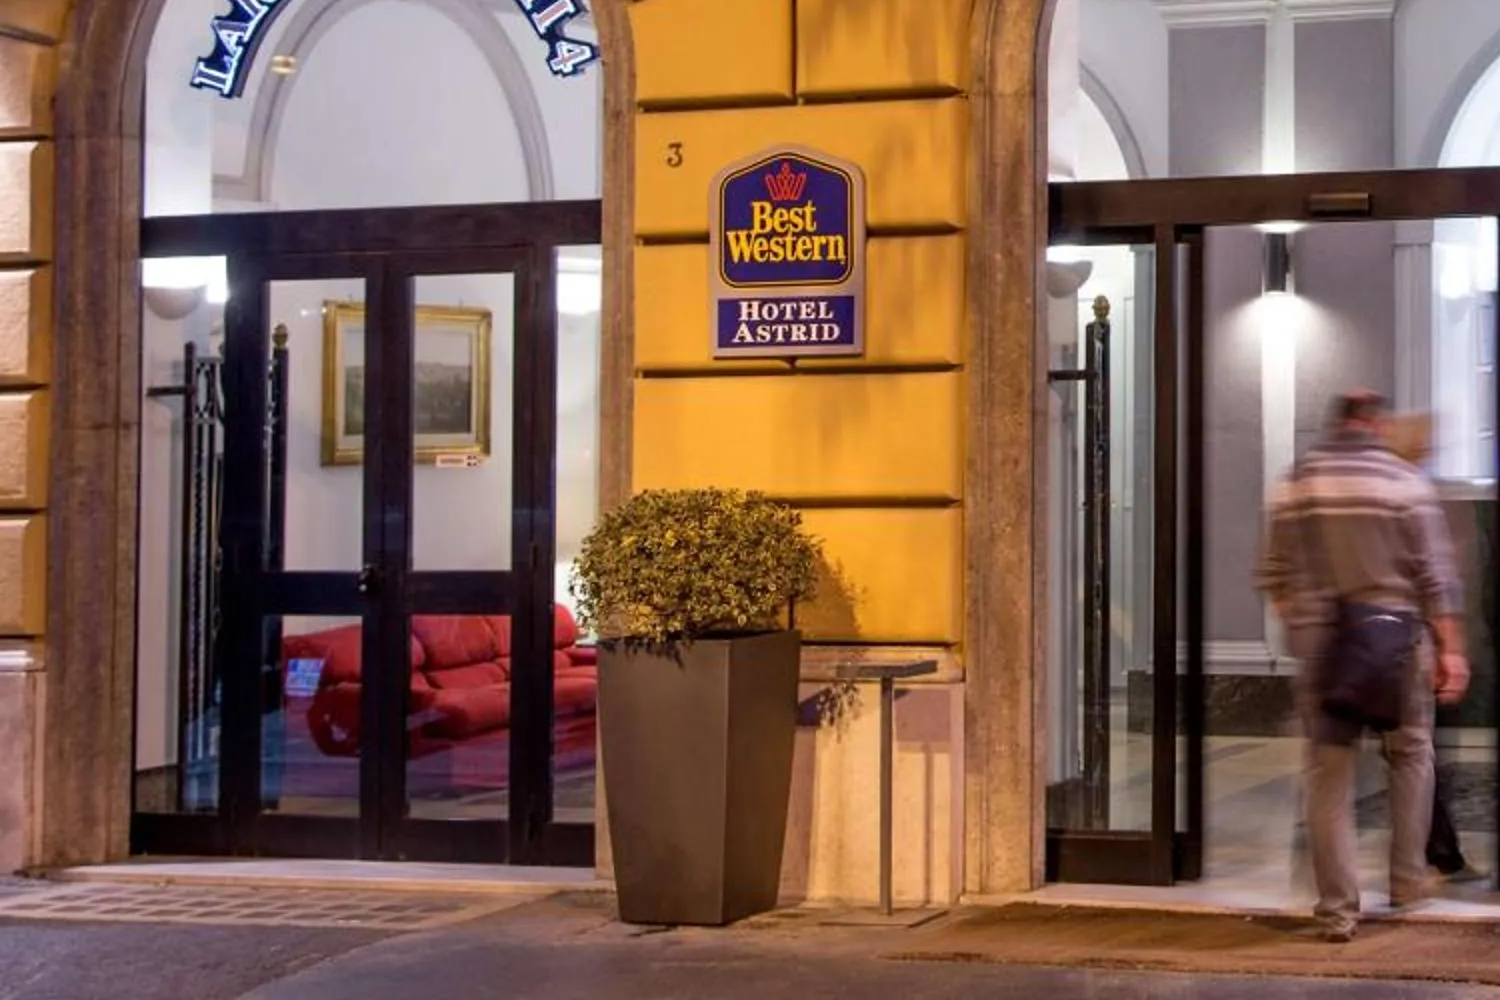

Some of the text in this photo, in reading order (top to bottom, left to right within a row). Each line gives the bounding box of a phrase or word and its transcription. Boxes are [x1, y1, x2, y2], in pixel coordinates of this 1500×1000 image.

[547, 36, 599, 77] 4
[666, 141, 684, 168] 3
[751, 200, 817, 233] Best
[726, 229, 846, 264] Western
[739, 301, 835, 320] HOTEL
[732, 321, 842, 342] ASTRID
